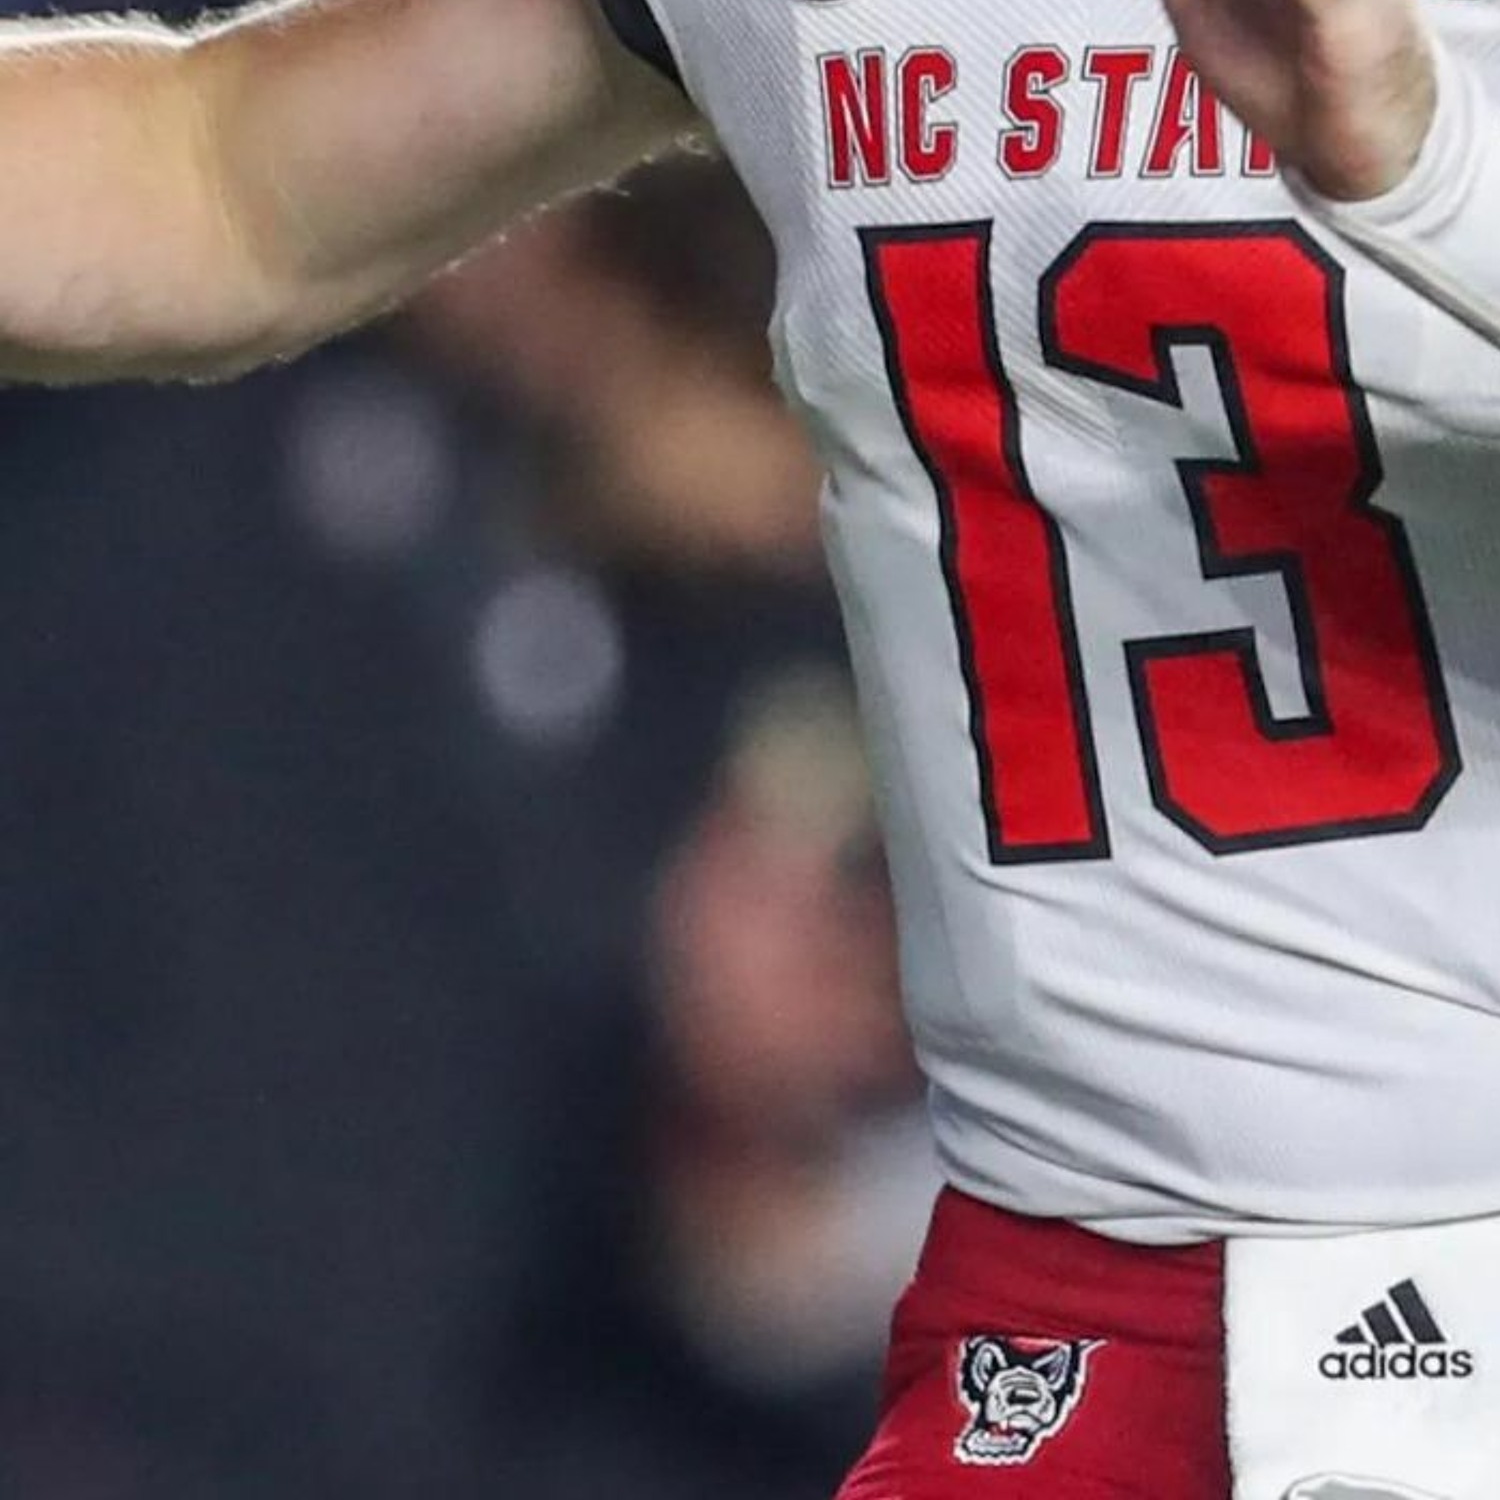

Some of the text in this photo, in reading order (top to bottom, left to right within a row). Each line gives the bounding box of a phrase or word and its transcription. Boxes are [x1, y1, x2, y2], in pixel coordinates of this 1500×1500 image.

[817, 43, 1277, 188] NC STA
[856, 218, 1463, 867] 13
[1317, 1343, 1474, 1380] adidas
